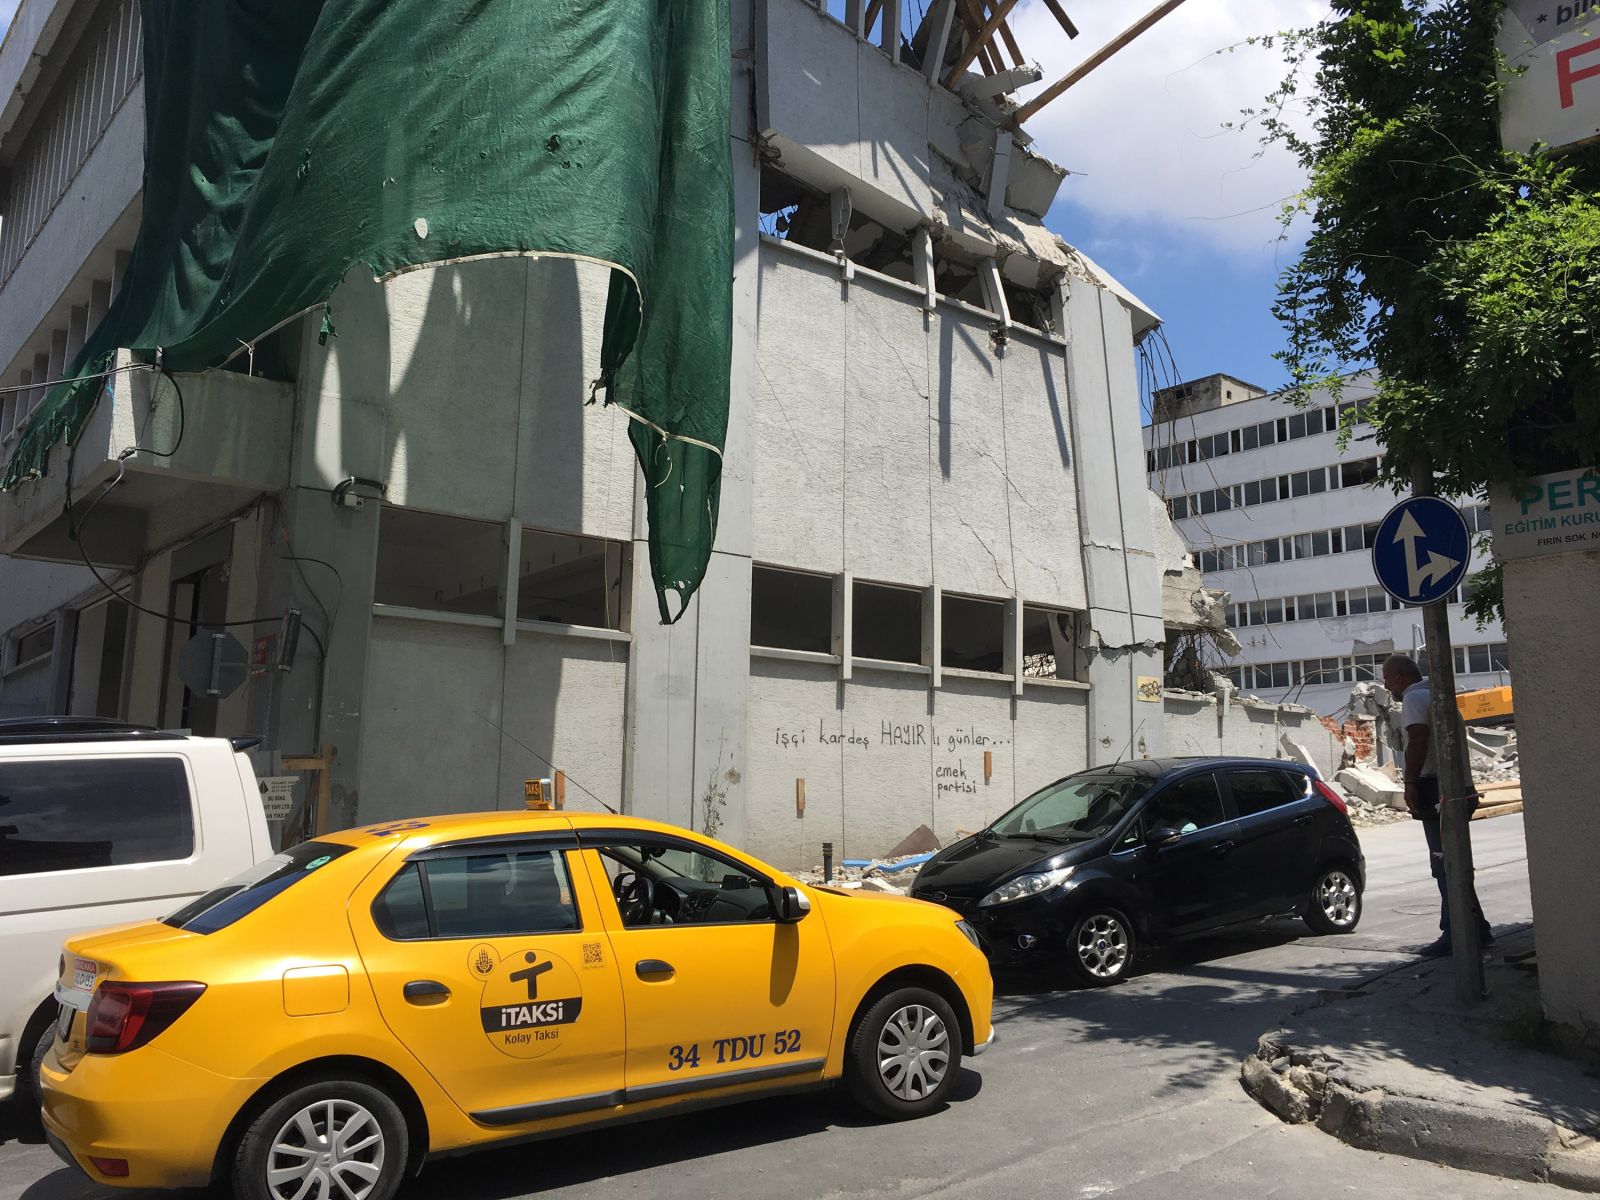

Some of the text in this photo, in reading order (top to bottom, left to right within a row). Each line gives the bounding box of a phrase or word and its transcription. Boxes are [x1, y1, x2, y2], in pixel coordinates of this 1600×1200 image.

[1504, 517, 1556, 536] EĞİTİM
[1537, 537, 1562, 547] FIRIN
[1591, 531, 1600, 540] N
[775, 727, 806, 748] işçi
[819, 718, 870, 749] kardeş
[936, 758, 967, 780] emek
[937, 780, 977, 799] partisi
[504, 1028, 559, 1045] Kolay Taksi
[668, 1029, 801, 1071] 34 TDU 52
